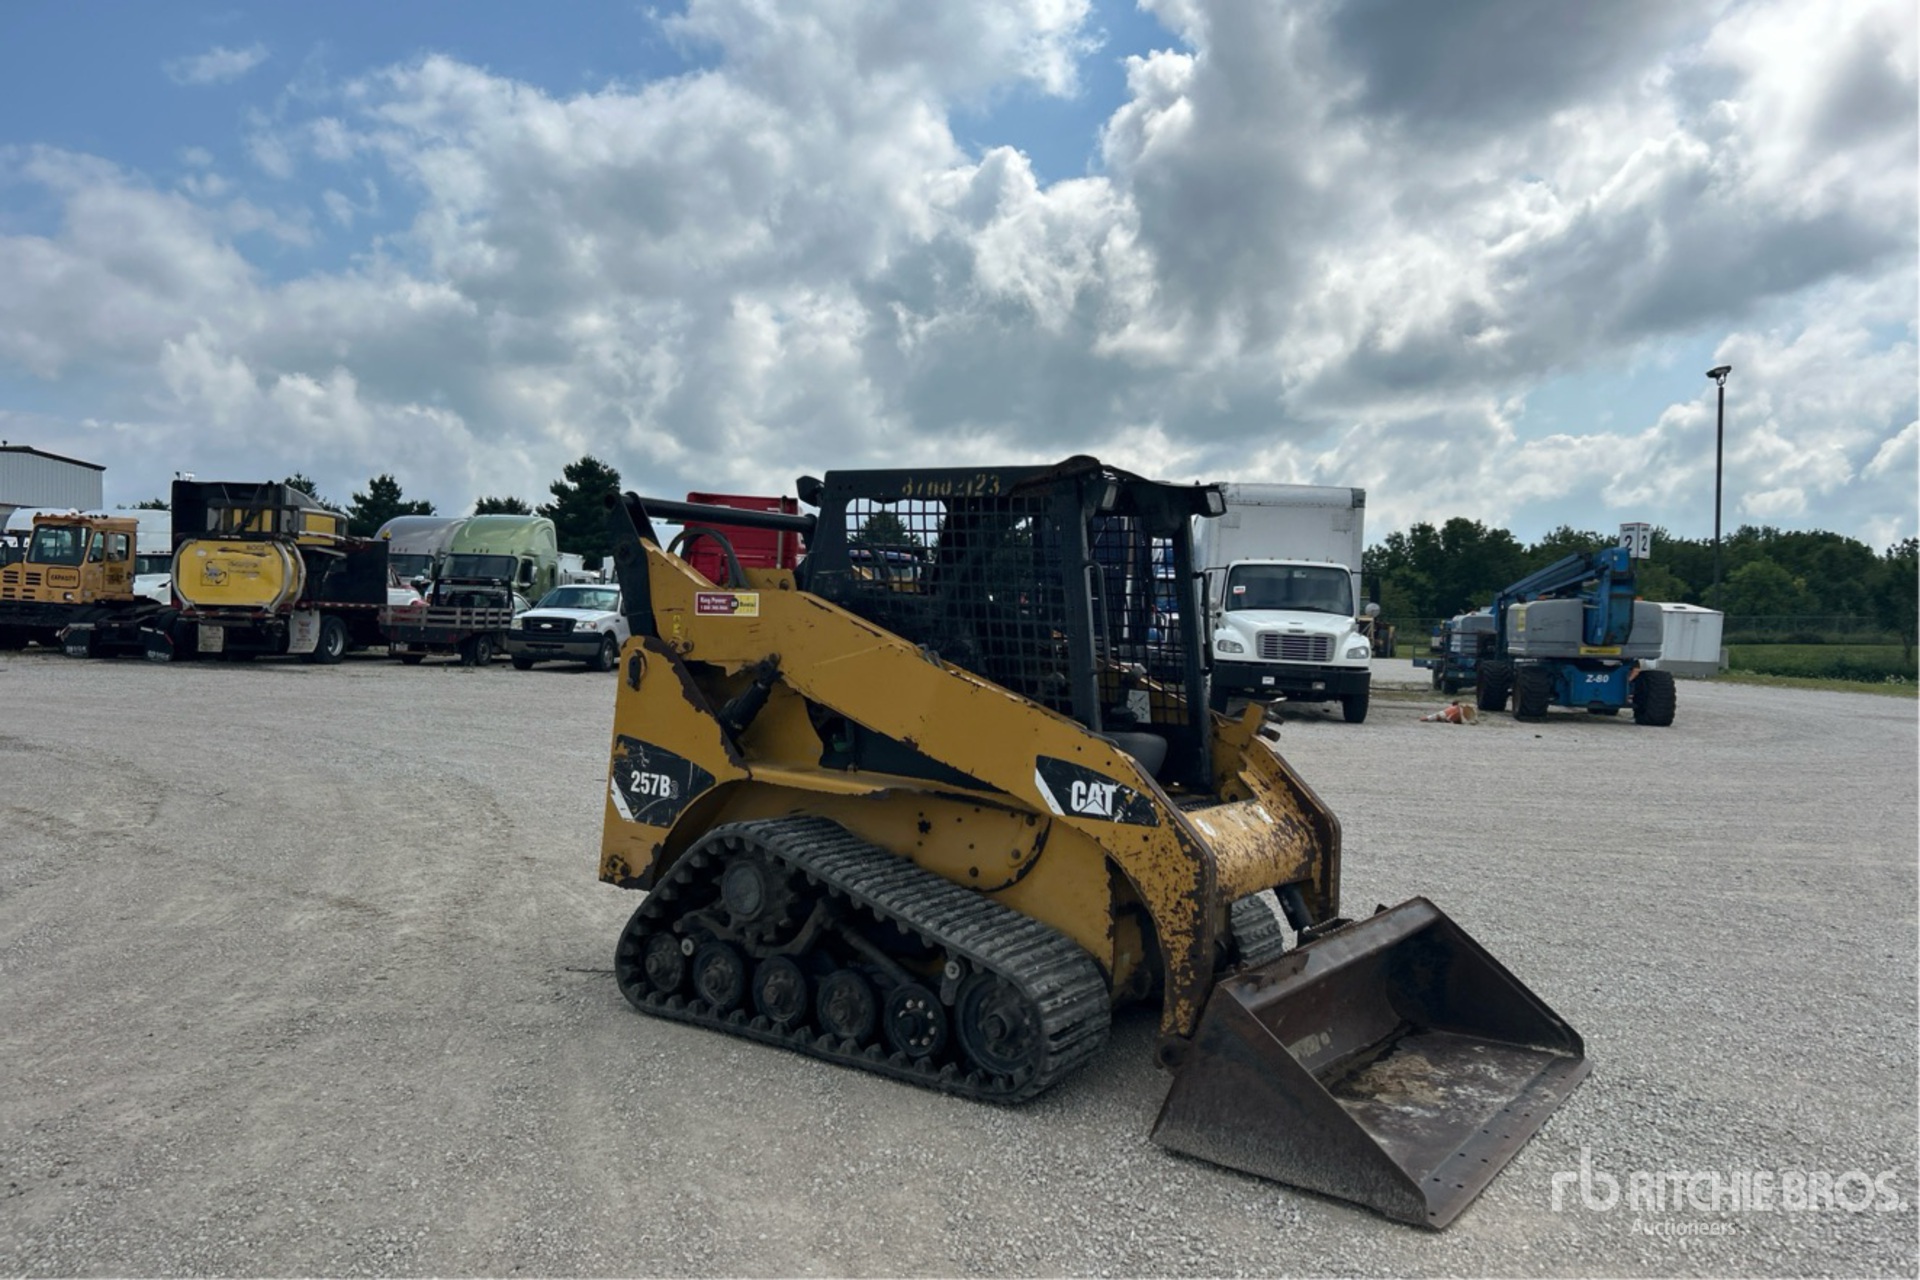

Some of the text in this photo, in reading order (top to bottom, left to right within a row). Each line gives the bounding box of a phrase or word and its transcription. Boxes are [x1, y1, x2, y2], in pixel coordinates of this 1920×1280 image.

[1624, 535, 1633, 551] 2
[1641, 535, 1648, 552] 2
[1586, 674, 1609, 683] Z-80
[1070, 780, 1117, 816] CAT
